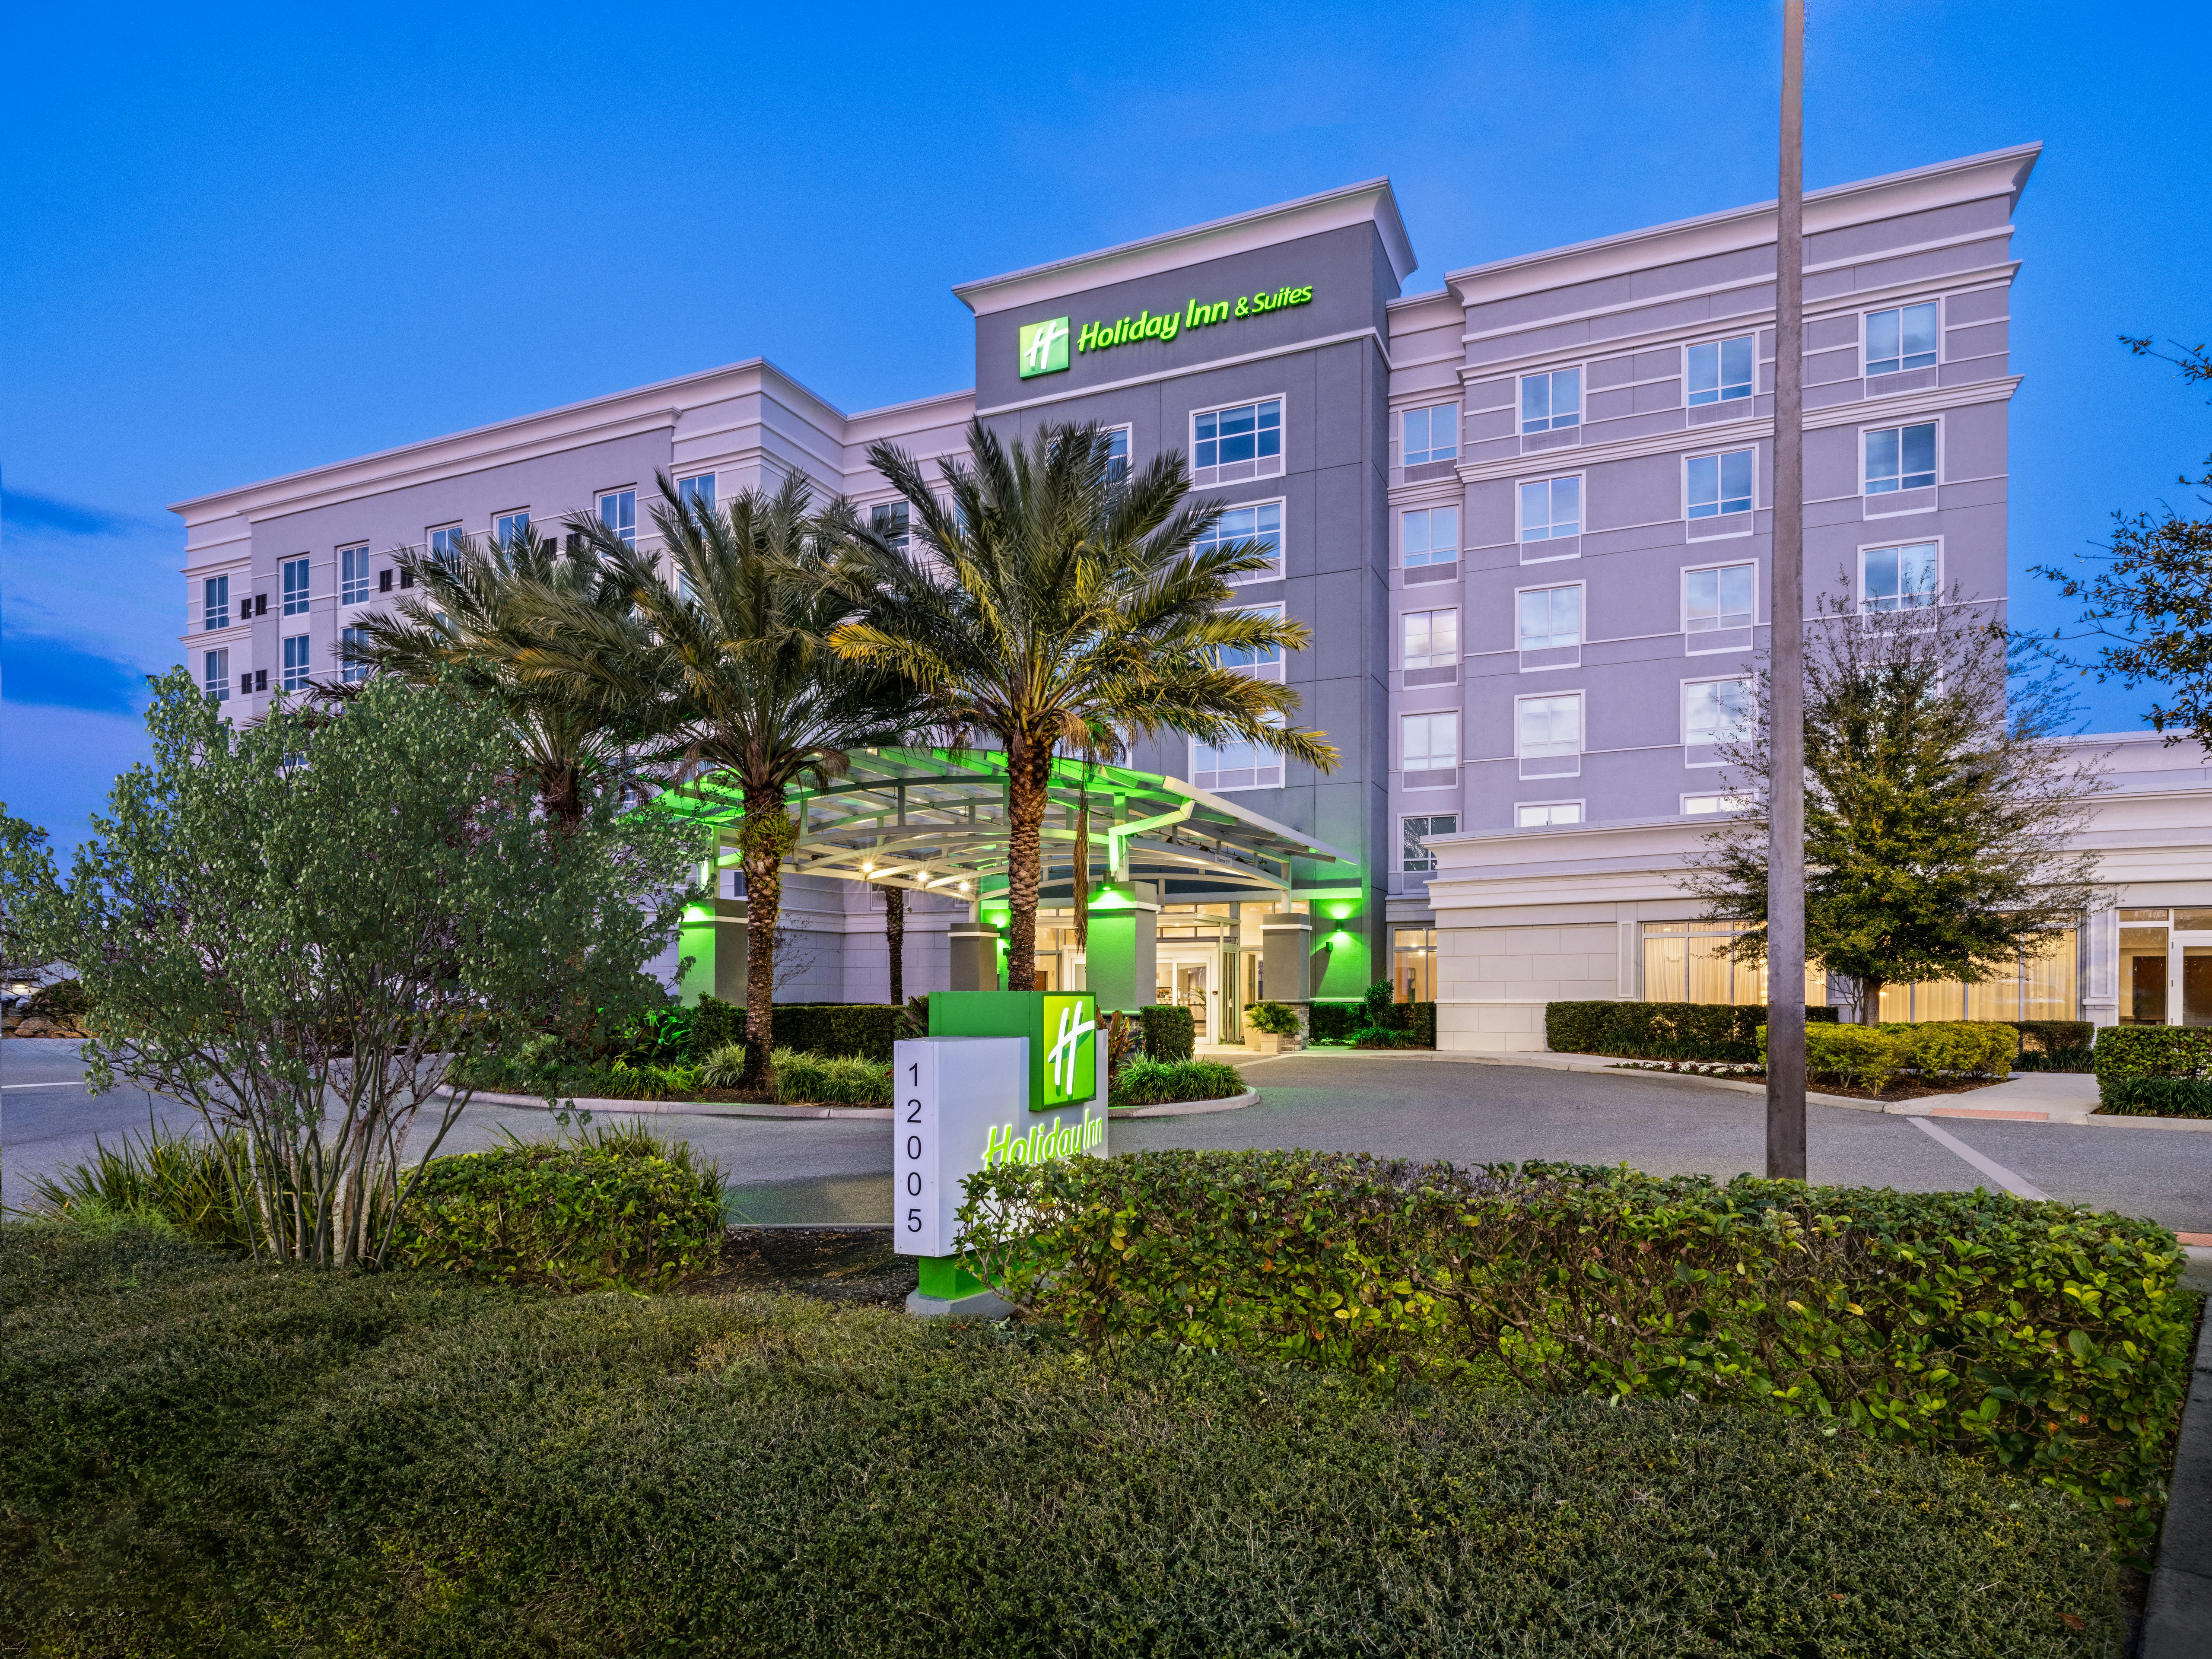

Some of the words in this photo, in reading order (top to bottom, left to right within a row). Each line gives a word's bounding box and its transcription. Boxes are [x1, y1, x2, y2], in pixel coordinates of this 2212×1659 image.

[1077, 311, 1181, 353] Holiday
[1185, 299, 1230, 329] Inn
[1234, 296, 1249, 318] &
[1252, 286, 1313, 315] Suites
[907, 1062, 922, 1233] 12005
[982, 1117, 1083, 1170] Holiday
[1083, 1109, 1103, 1150] Inn
